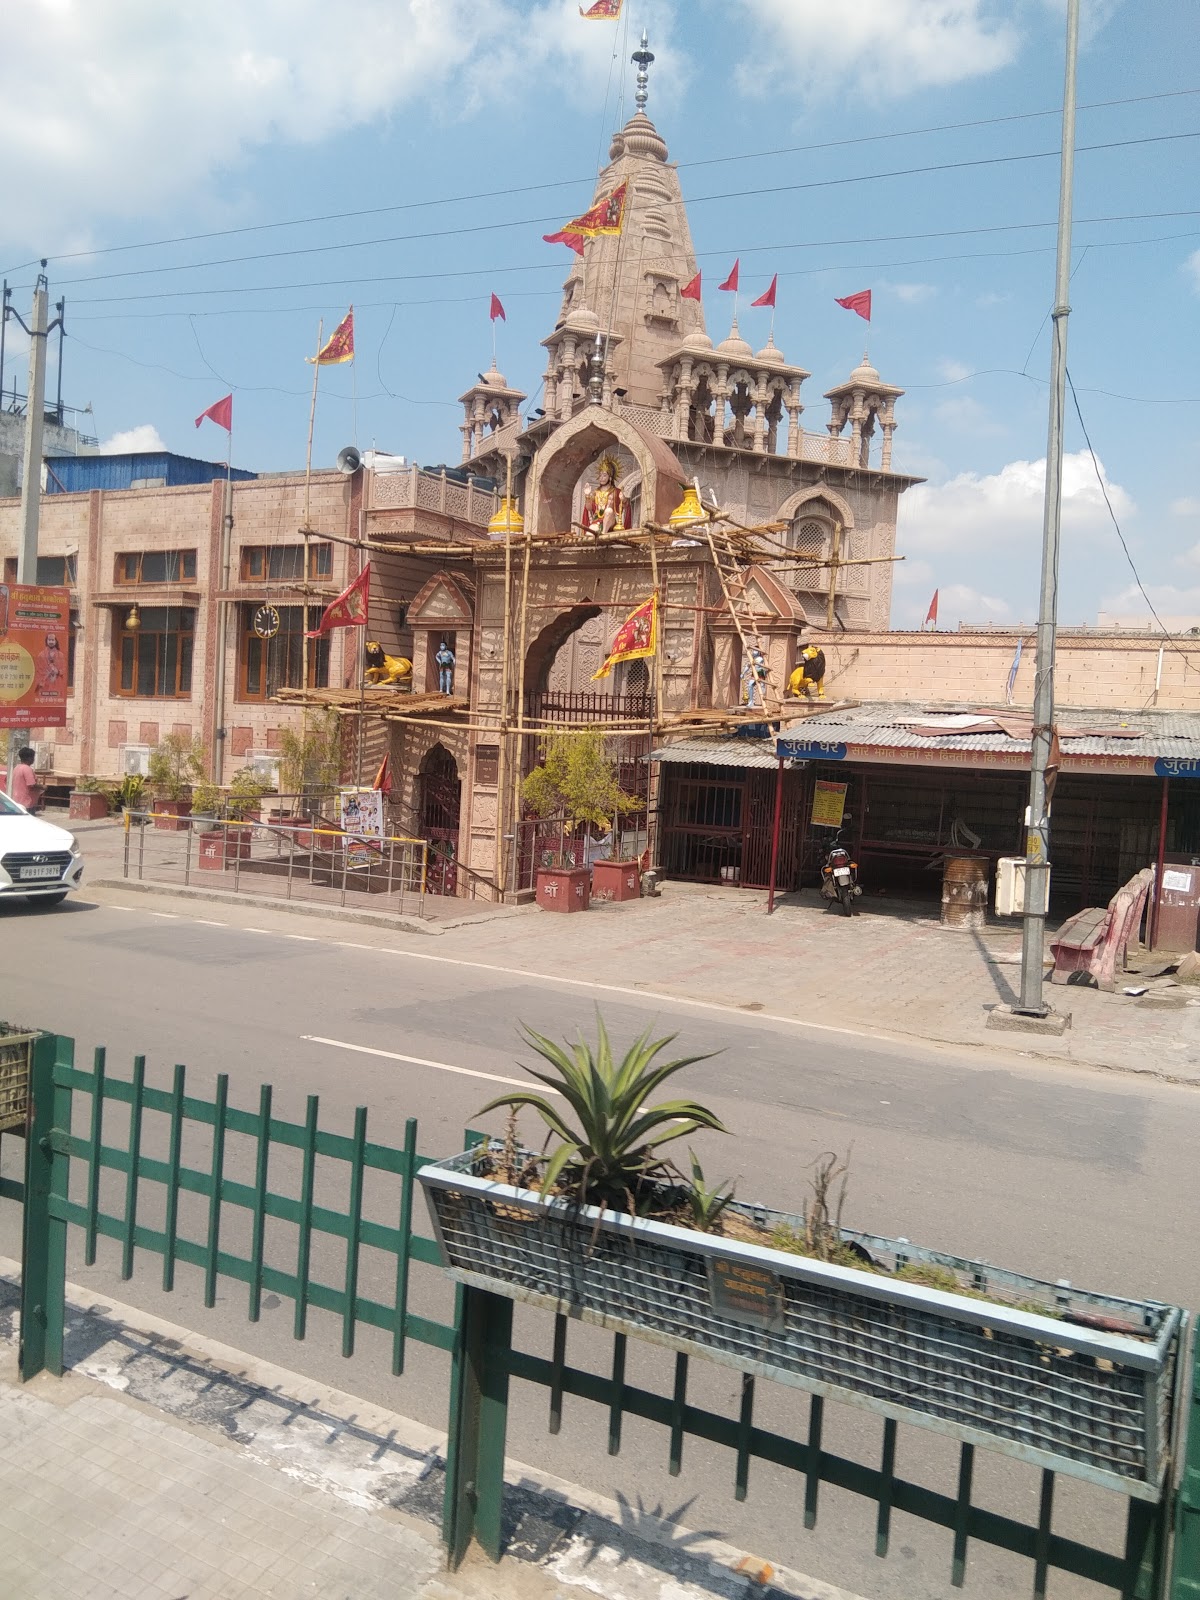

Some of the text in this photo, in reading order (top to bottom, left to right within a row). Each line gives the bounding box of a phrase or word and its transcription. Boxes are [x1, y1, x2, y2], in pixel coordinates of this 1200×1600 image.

[874, 747, 896, 759] भगत
[900, 747, 920, 760] जनों
[924, 749, 935, 761] से
[983, 751, 997, 764] कि
[1002, 754, 1026, 766] अपने
[1081, 758, 1095, 768] घर
[204, 843, 217, 859] माँ
[543, 880, 559, 898] माँ
[575, 880, 585, 897] माँ
